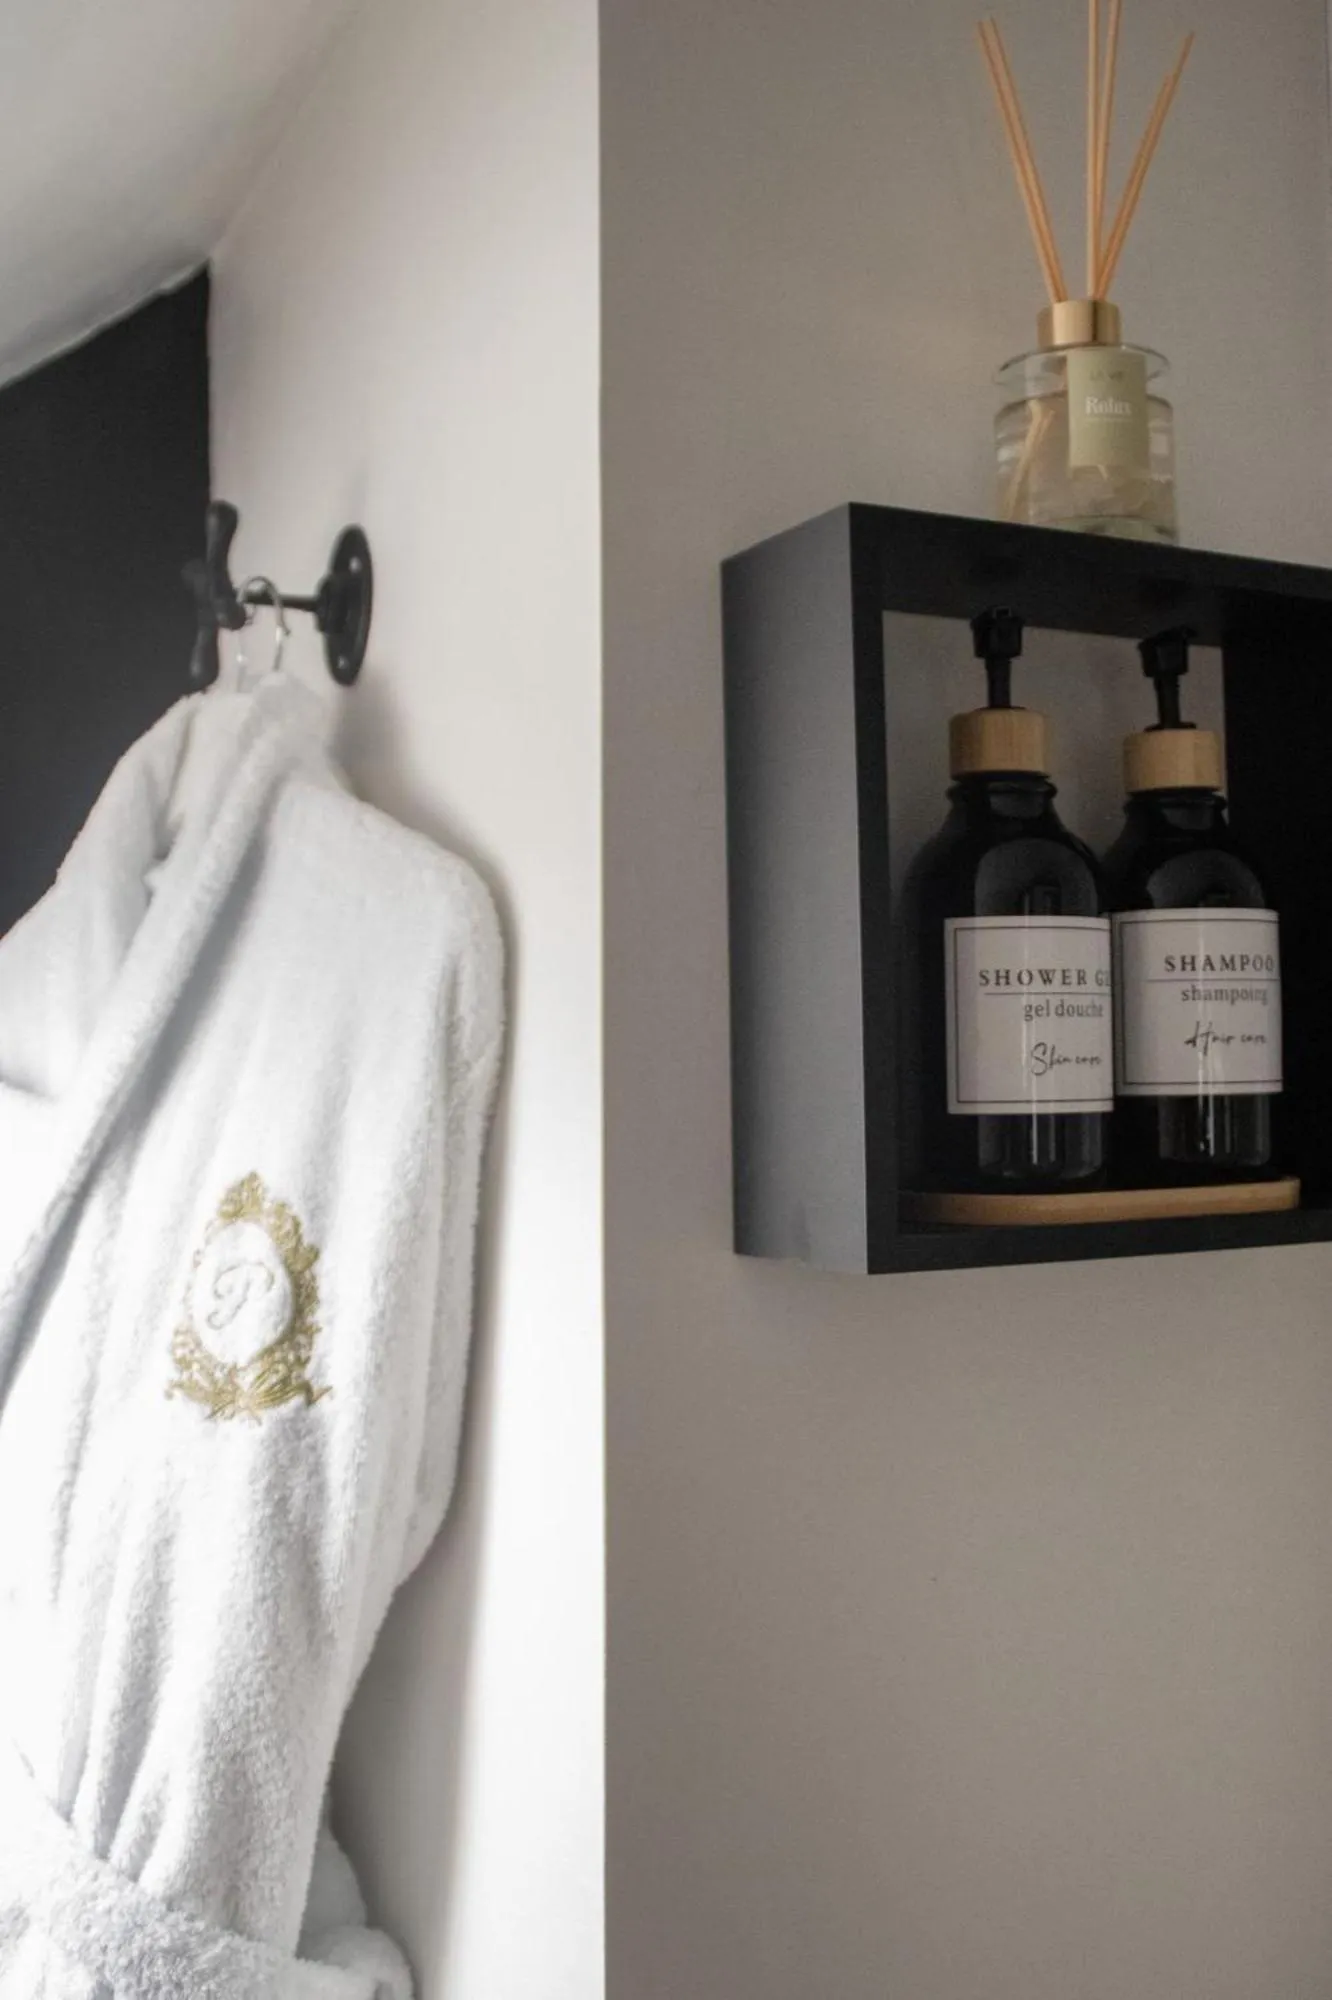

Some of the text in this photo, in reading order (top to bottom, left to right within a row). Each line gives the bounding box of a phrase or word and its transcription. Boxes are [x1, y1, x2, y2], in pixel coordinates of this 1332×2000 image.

[1164, 953, 1275, 973] SHAMPOO
[979, 968, 1088, 987] SHOWER
[1181, 984, 1268, 1007] shampoing
[1024, 998, 1104, 1022] gel douche
[1030, 1041, 1072, 1077] Skin
